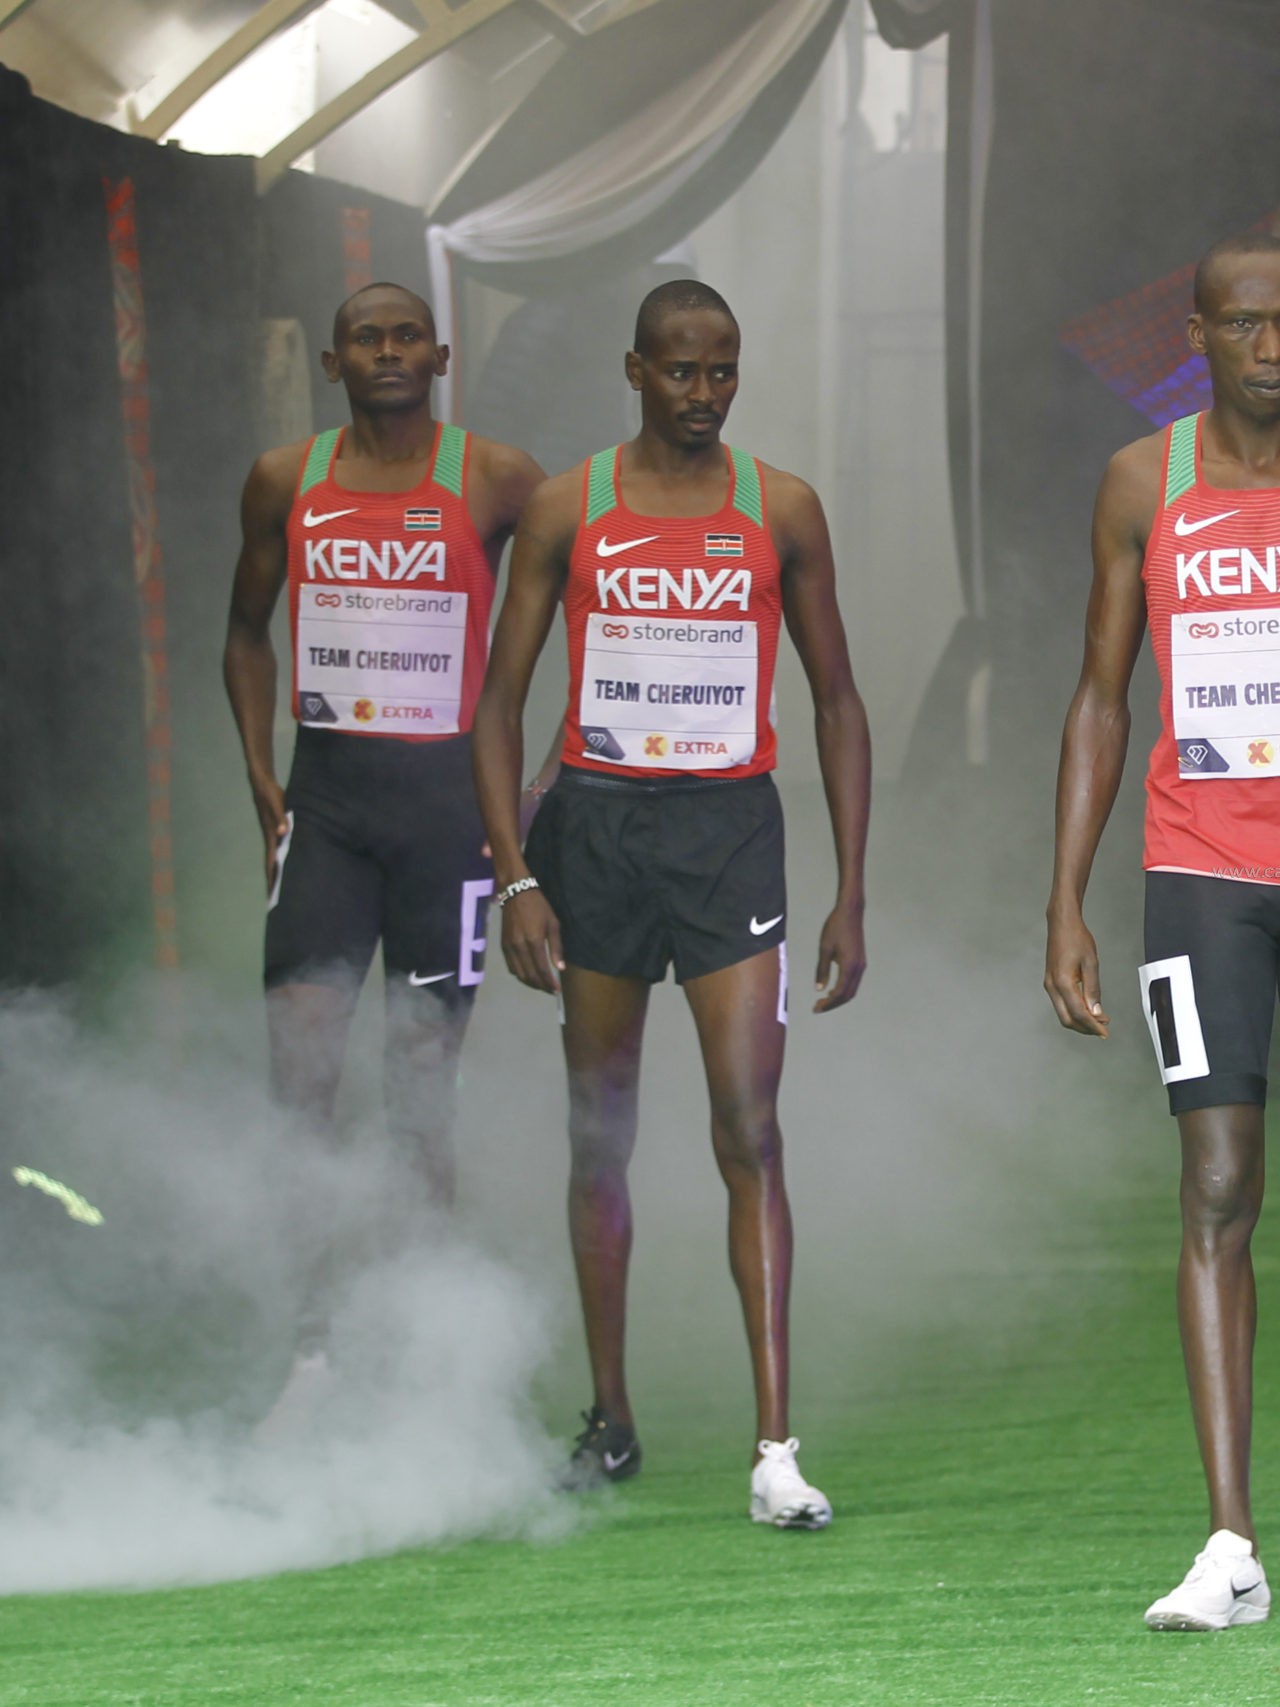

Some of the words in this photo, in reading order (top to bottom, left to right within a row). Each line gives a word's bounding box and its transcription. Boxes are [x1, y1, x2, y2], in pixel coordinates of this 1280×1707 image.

[305, 538, 447, 581] KENYA
[596, 567, 752, 611] KENYA
[345, 592, 452, 613] storebrand
[632, 624, 743, 643] storebrand
[309, 647, 350, 668] TEAM
[356, 650, 452, 673] CHERUIYOT
[595, 679, 640, 702] TEAM
[647, 683, 745, 705] CHERUIYOT
[1185, 684, 1237, 709] TEAM
[381, 706, 434, 720] EXTRA
[674, 741, 728, 755] EXTRA
[1149, 976, 1181, 1070] 1
